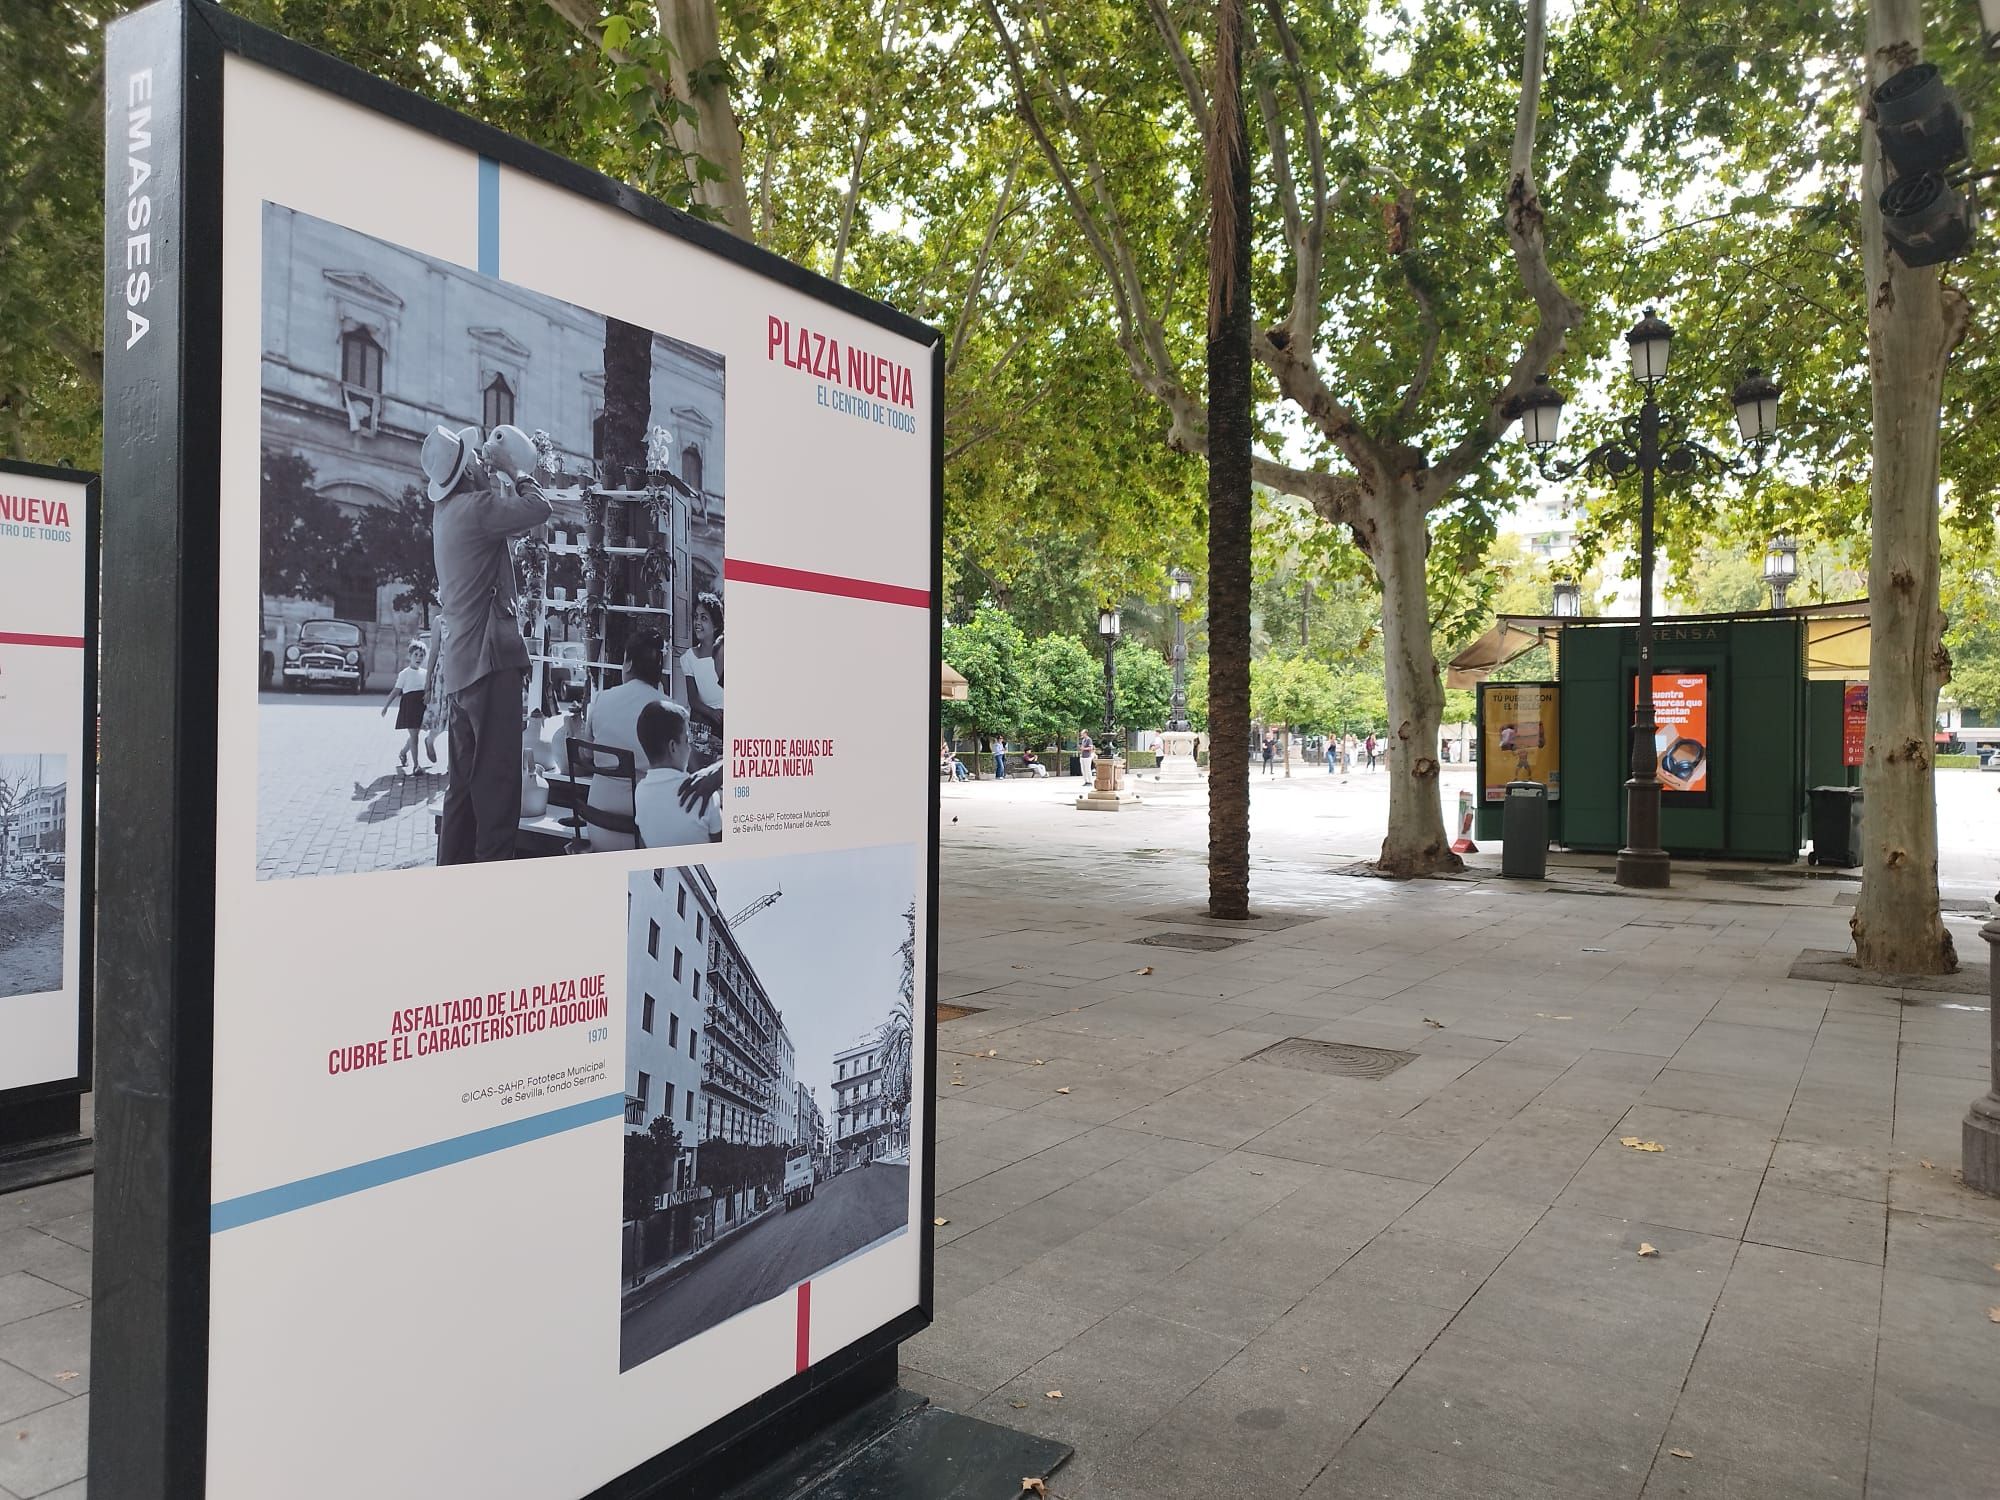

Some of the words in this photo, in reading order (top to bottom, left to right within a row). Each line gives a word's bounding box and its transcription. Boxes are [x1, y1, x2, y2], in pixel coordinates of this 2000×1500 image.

[127, 68, 152, 350] EMASESA
[768, 315, 841, 384] PLAZA
[848, 346, 914, 409] NUEVA
[817, 385, 829, 407] EL
[832, 390, 870, 420] CENTRO
[872, 403, 884, 424] DE
[887, 408, 916, 434] TODOS
[0, 494, 69, 527] NUEVA
[0, 524, 19, 536] TRO
[22, 526, 36, 538] DE
[39, 528, 71, 543] TODOS
[1677, 678, 1703, 686] amazon
[1652, 691, 1684, 699] cuentra
[1685, 700, 1702, 708] que
[733, 739, 771, 757] PUESTO
[775, 739, 787, 757] DE
[790, 739, 820, 757] AGUAS
[823, 740, 833, 756] DE
[733, 760, 745, 778] LA
[749, 759, 780, 777] PLAZA
[783, 759, 814, 776] NUEVA
[734, 786, 750, 798] 1968
[777, 812, 802, 821] Fototeca
[804, 809, 830, 819] Municipal
[732, 826, 741, 834] de
[765, 822, 782, 831] fondo
[784, 820, 804, 830] Manuel
[806, 819, 813, 828] de
[814, 819, 831, 827] Arcos.
[392, 996, 482, 1036] ASFALTADO
[487, 992, 506, 1016] DE
[511, 988, 528, 1012] LA
[533, 980, 576, 1008] PLAZA
[580, 974, 605, 999] QUE
[329, 1039, 388, 1075] CUBRE
[393, 1035, 413, 1061] EL
[418, 1009, 546, 1056] CARACTERÍSTICO
[550, 994, 608, 1028] ADOQUÍN
[588, 1027, 608, 1044] 1970
[527, 1071, 565, 1088] Fototeca
[567, 1058, 606, 1077] Municipal
[500, 1096, 512, 1106] de
[514, 1087, 545, 1102] Sevilla,
[546, 1081, 572, 1094] fondo
[573, 1071, 608, 1087] Serrano.
